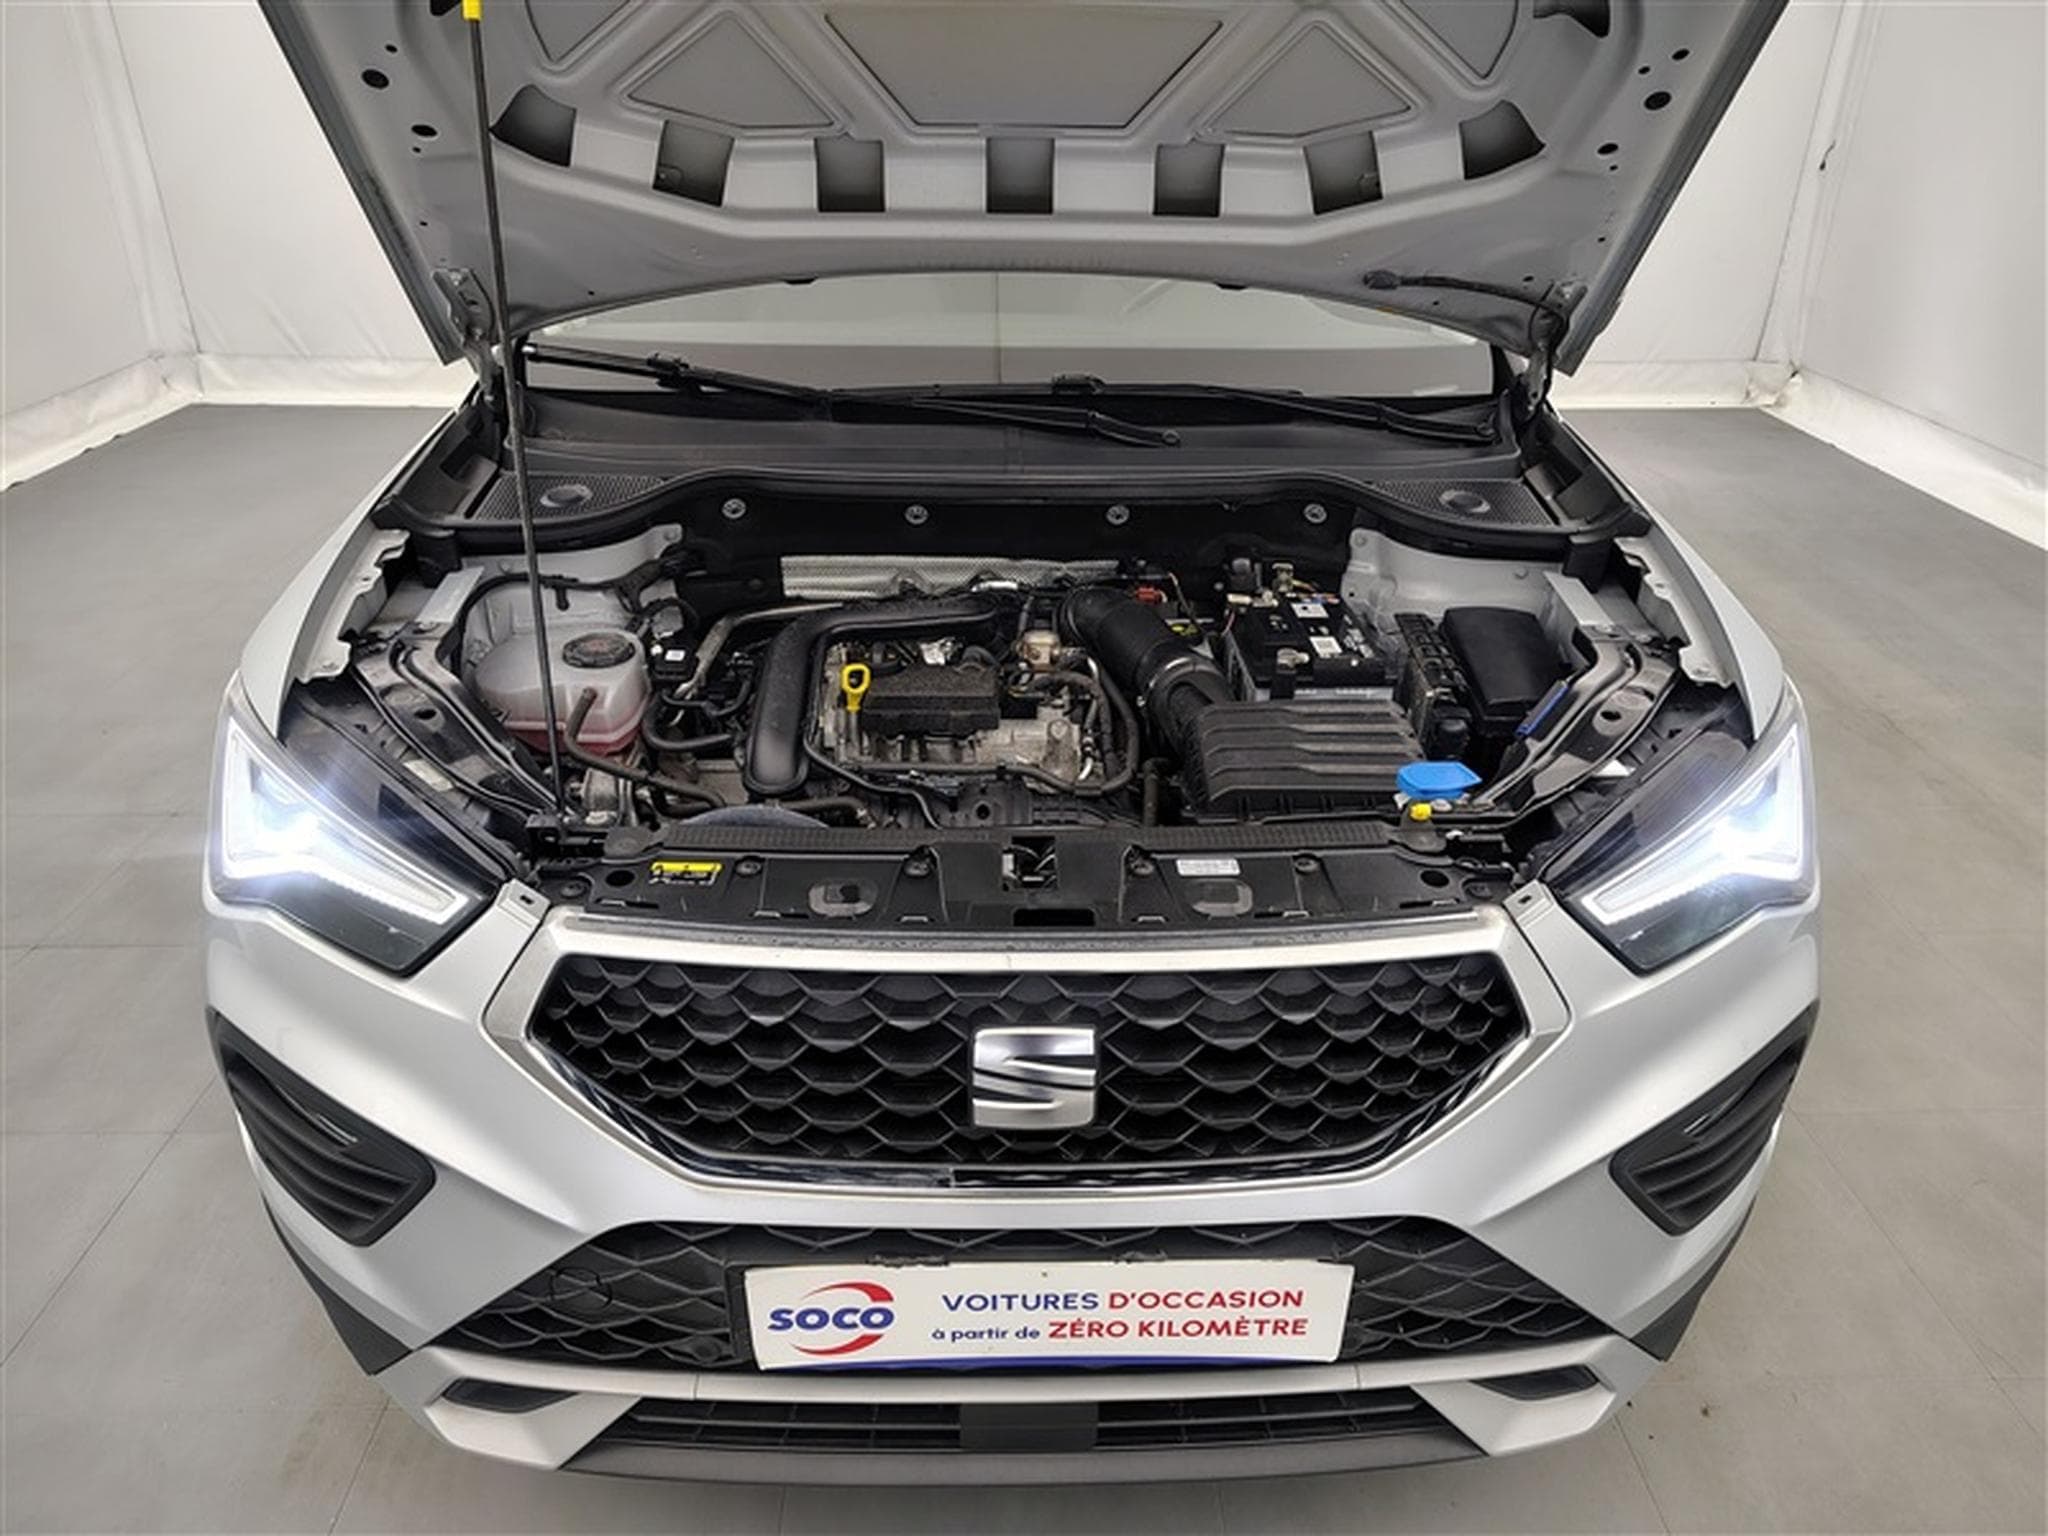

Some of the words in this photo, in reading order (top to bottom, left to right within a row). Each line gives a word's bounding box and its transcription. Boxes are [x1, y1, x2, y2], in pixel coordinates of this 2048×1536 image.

[941, 1292, 1099, 1311] VOITURES
[1108, 1290, 1304, 1309] D'OCCASION
[767, 1306, 895, 1331] SOCO
[931, 1326, 946, 1340] à
[950, 1326, 1009, 1342] partir
[1014, 1327, 1041, 1340] de
[1048, 1319, 1130, 1339] ZÉRO
[1138, 1317, 1308, 1338] KILOMÈTRE
